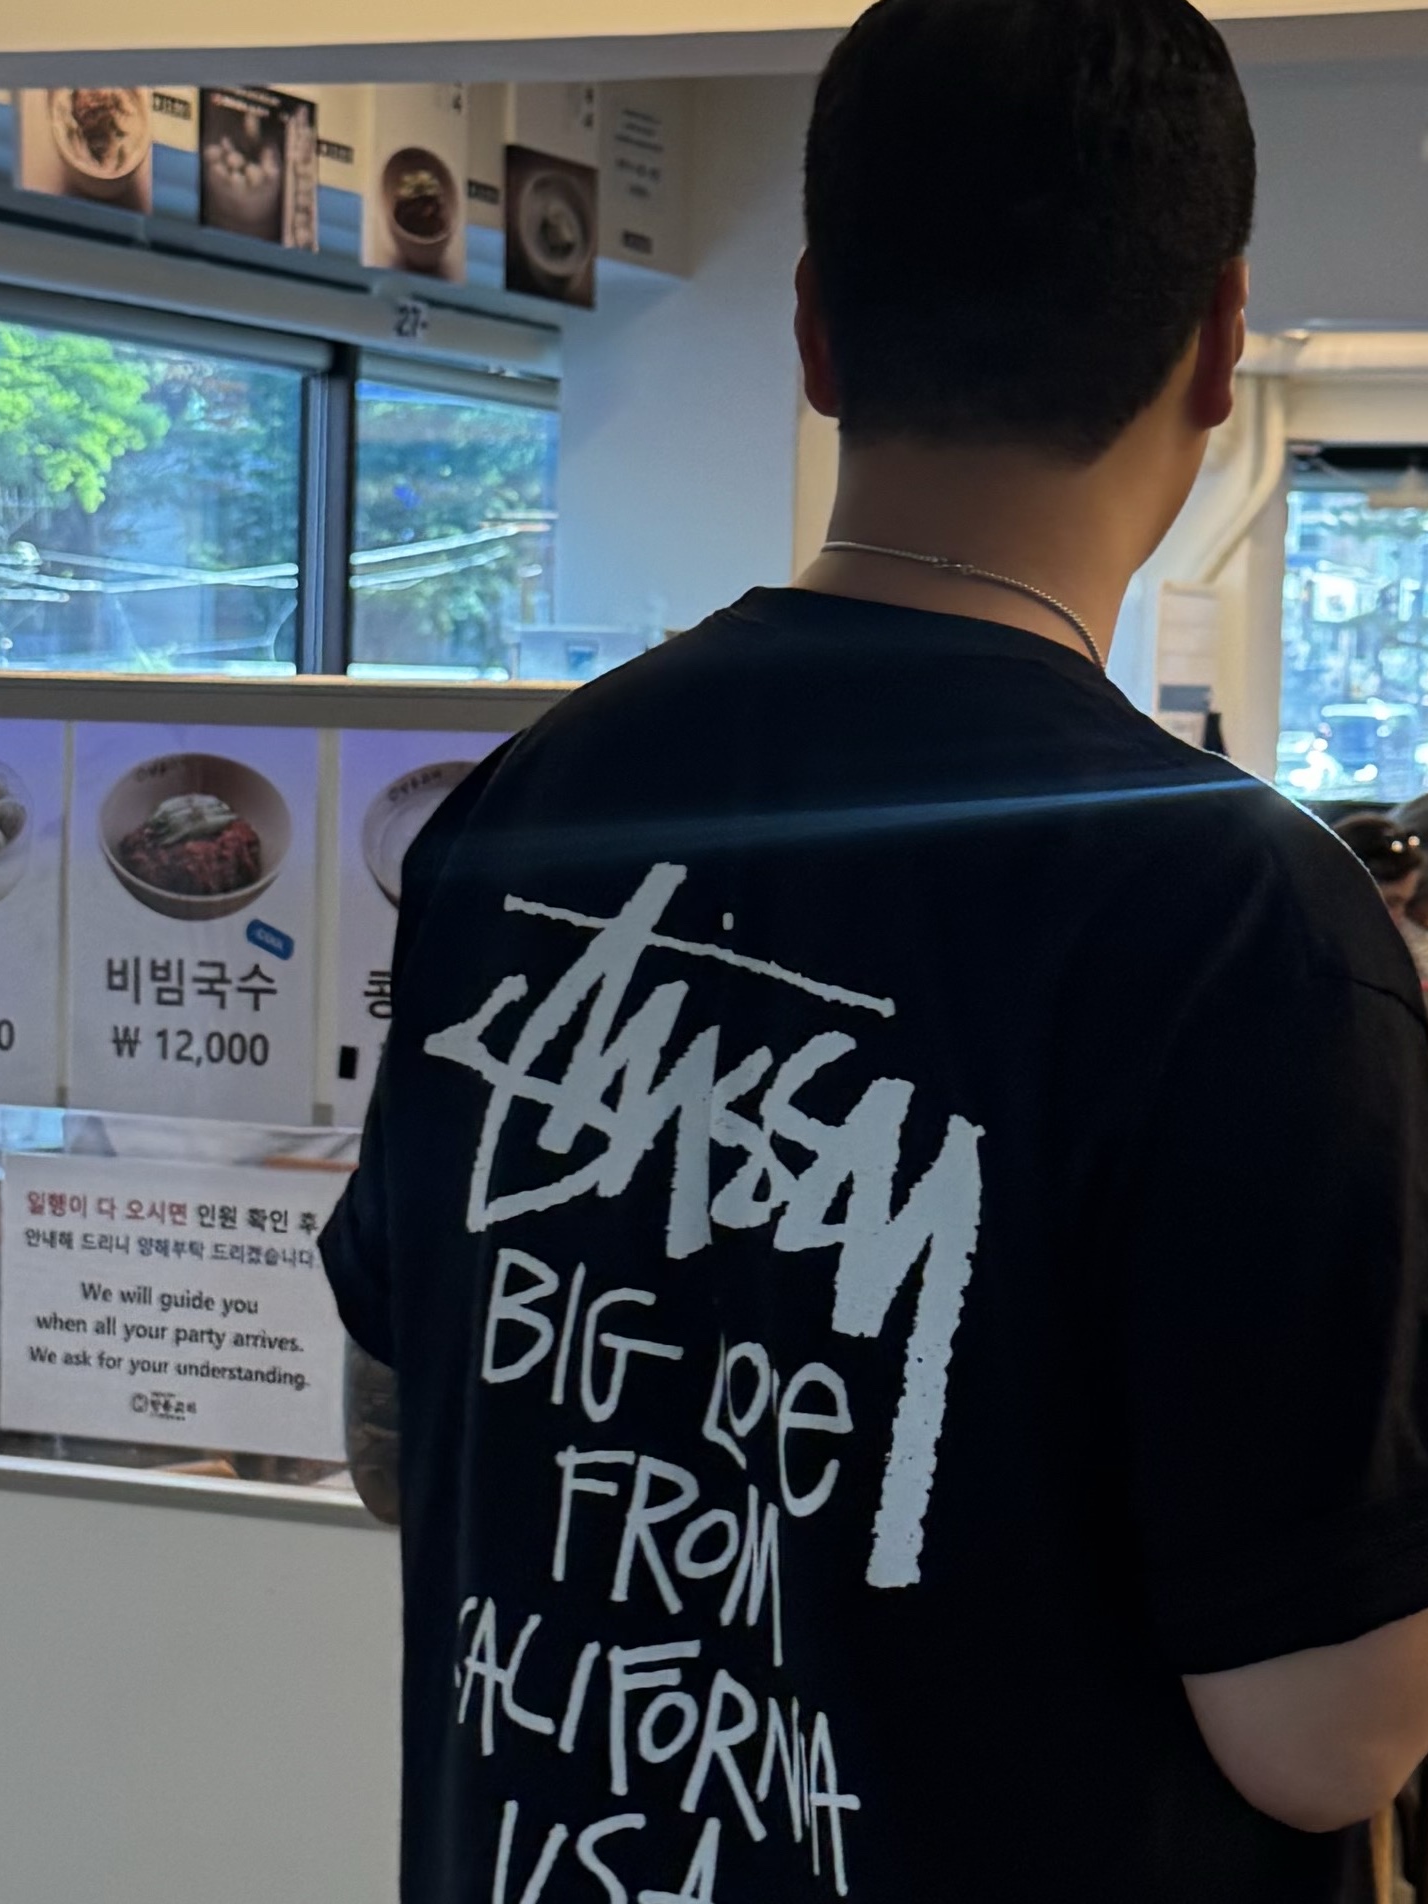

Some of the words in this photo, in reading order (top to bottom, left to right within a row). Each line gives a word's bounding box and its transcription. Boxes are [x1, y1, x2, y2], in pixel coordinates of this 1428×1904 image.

[107, 956, 278, 1012] 비빔국수
[156, 1028, 270, 1067] 12,000
[27, 1190, 88, 1218] 일행이
[96, 1197, 117, 1220] 다
[125, 1199, 188, 1226] 오시면
[197, 1204, 238, 1230] 인원
[247, 1208, 289, 1234] 확인
[25, 1228, 74, 1250] 안내해
[81, 1233, 130, 1255] 드리니
[80, 1281, 113, 1302] We
[120, 1286, 152, 1306] will
[160, 1289, 215, 1313] guide
[222, 1297, 259, 1317] you
[36, 1313, 87, 1333] when
[94, 1317, 116, 1336] all
[123, 1324, 168, 1343] your
[175, 1326, 226, 1350] party
[233, 1329, 304, 1352] arrives.
[481, 1248, 684, 1422] BIG
[29, 1345, 57, 1364] We
[63, 1348, 92, 1367] ask
[98, 1350, 122, 1369] for
[129, 1357, 169, 1376] your
[176, 1361, 310, 1391] understanding.
[556, 1445, 783, 1667] FROM
